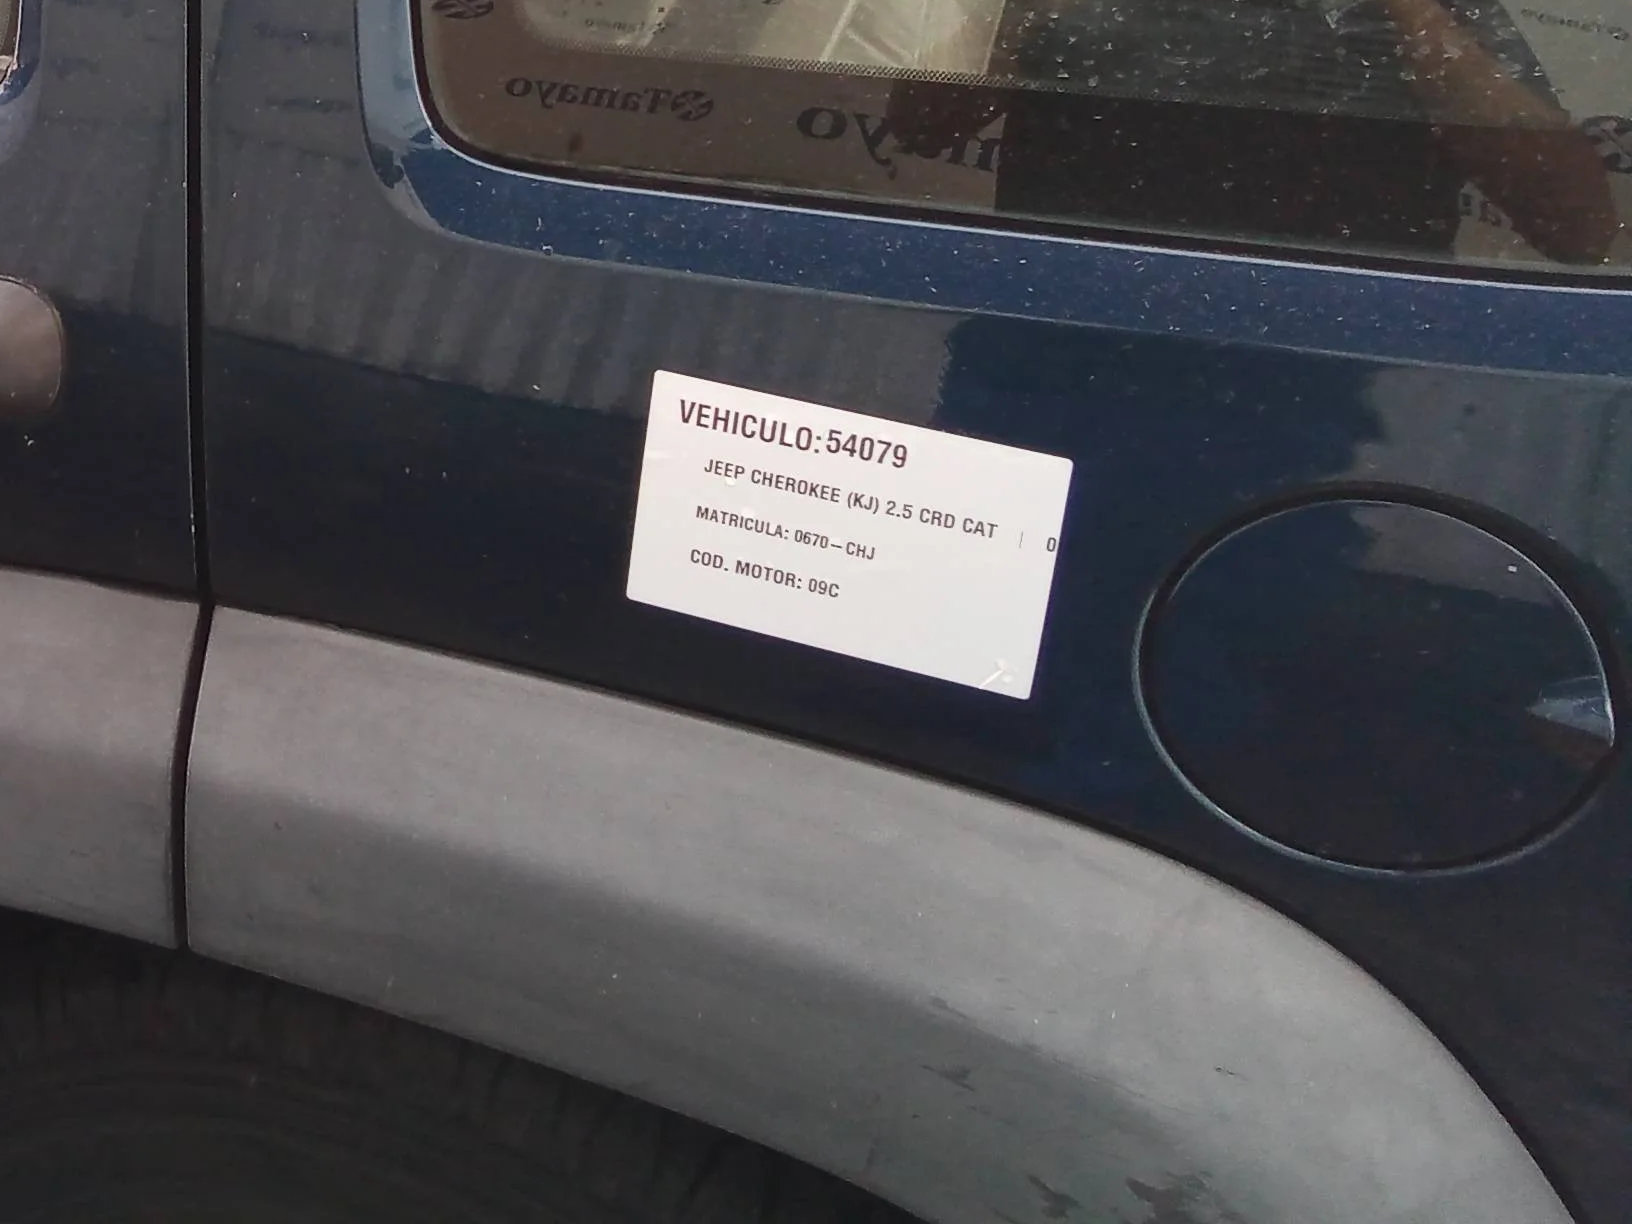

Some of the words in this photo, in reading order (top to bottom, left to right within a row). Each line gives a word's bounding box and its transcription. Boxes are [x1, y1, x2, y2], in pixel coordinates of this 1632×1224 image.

[704, 459, 745, 480] JEEP
[751, 469, 841, 503] CHEROKEE
[847, 492, 880, 515] (KJ)
[886, 500, 913, 520] 2.5
[919, 507, 956, 529] CRD
[962, 517, 999, 539] CAT
[696, 505, 790, 540] MATRICULA:
[794, 529, 876, 561] 0670-CHJ
[690, 549, 729, 572] COD.
[735, 559, 803, 590] MOTOR:
[808, 577, 840, 598] 09C
